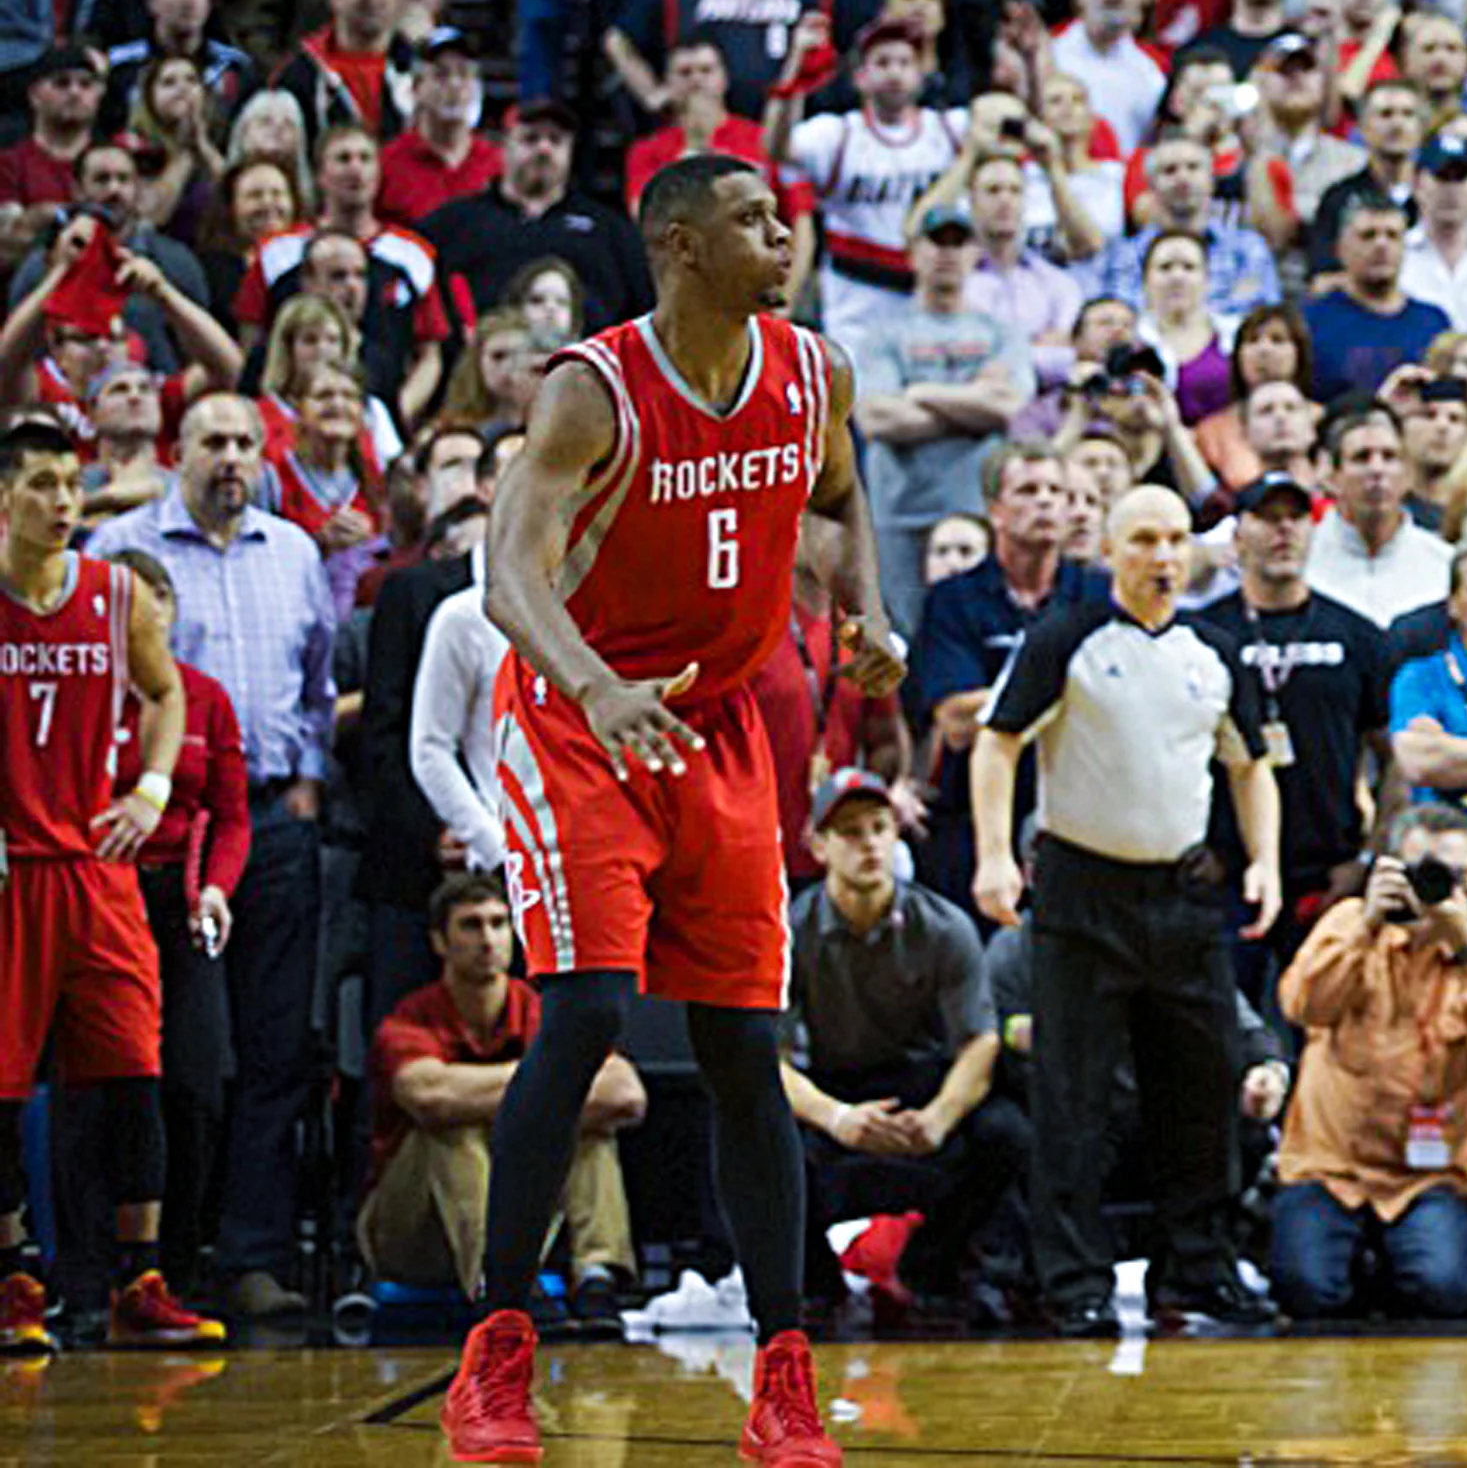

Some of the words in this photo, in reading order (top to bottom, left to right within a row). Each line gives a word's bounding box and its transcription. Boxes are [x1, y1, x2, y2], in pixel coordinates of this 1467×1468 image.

[649, 442, 800, 504] ROCKETS
[706, 506, 739, 590] 6
[0, 641, 109, 676] OCKETS
[29, 682, 59, 747] 7
